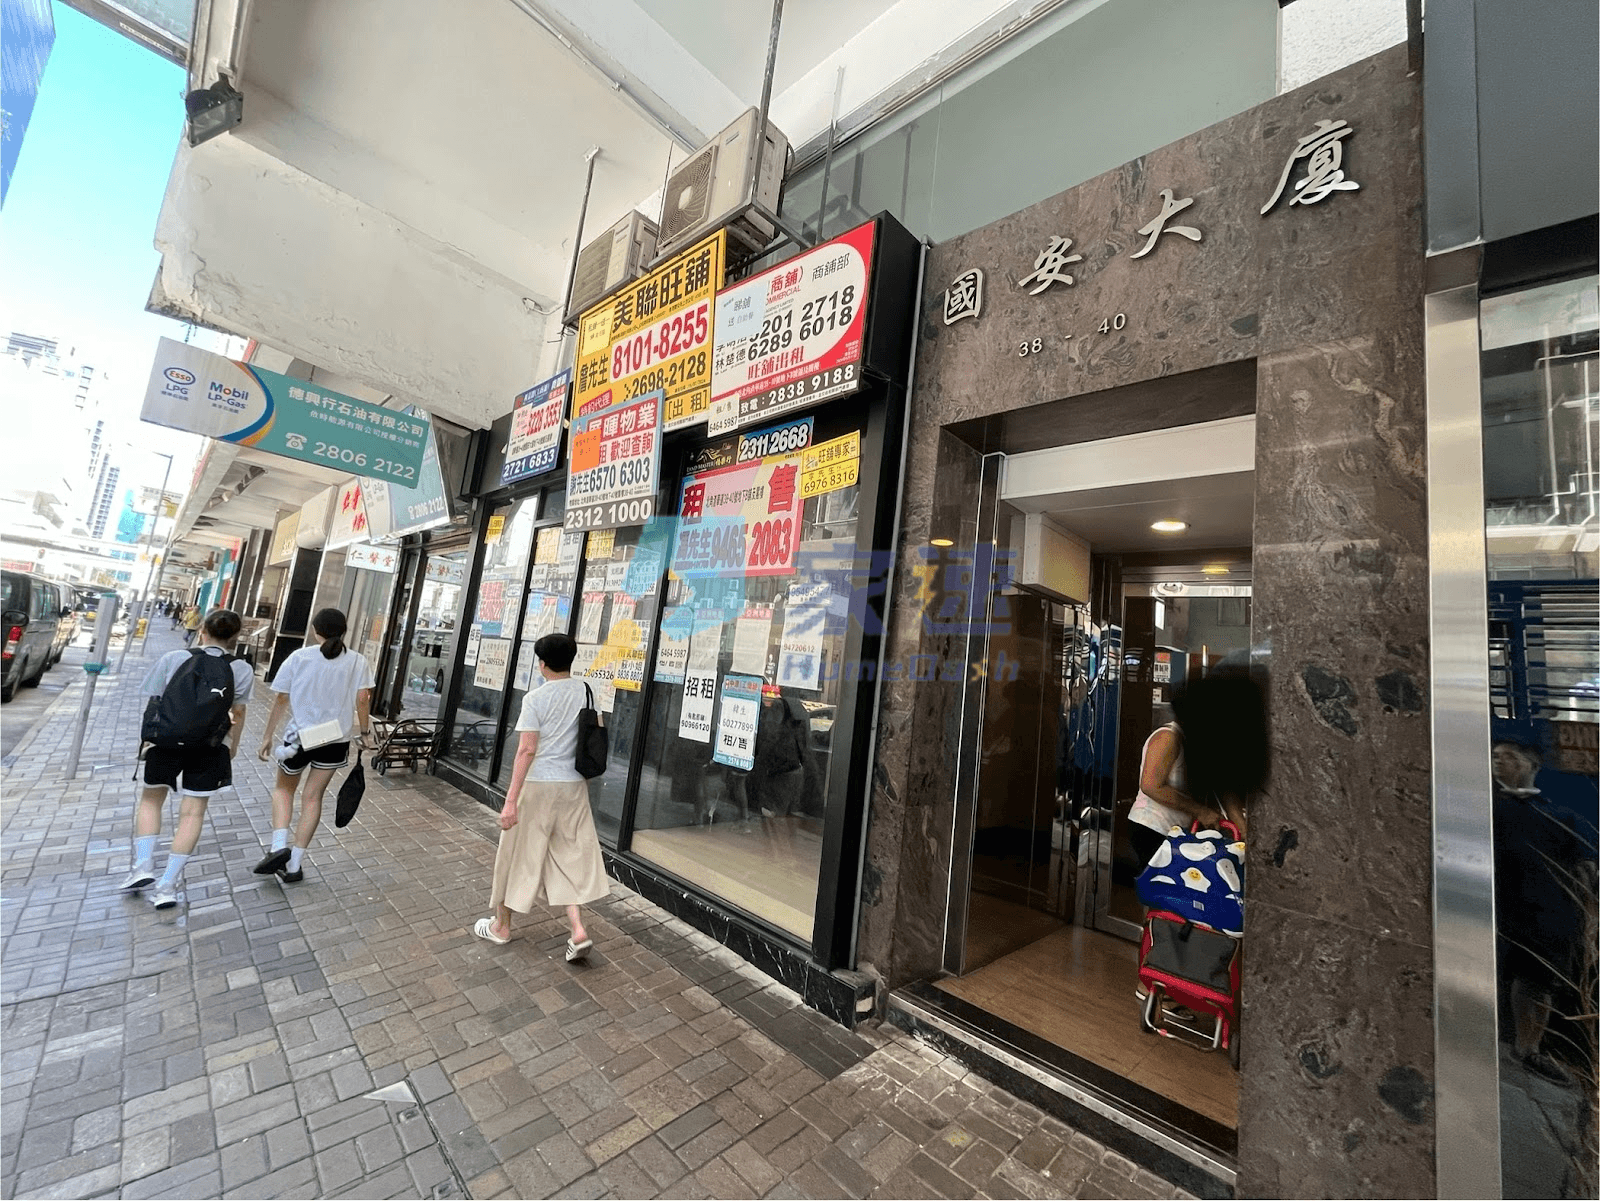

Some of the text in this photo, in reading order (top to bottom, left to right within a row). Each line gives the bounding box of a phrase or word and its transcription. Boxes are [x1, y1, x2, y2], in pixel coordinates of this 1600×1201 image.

[812, 252, 850, 282] 商舖部
[613, 249, 711, 334] 美聯旺舖
[801, 285, 855, 322] 2718
[613, 303, 708, 379] 8101-8255
[748, 330, 793, 361] 6289
[800, 305, 853, 341] 6018
[1018, 336, 1043, 357] 38
[1097, 313, 1126, 334] 40
[166, 383, 189, 395] LPG
[208, 392, 247, 410] LP-Gas
[210, 381, 249, 401] Mobil
[769, 381, 805, 406] 2838
[811, 364, 854, 391] 9188
[288, 386, 424, 438] 德興行石油有限公司
[313, 441, 415, 481] 2806 2122
[503, 459, 526, 478] 2721
[529, 448, 555, 468] 6833
[610, 432, 654, 462] 歡迎查詢
[589, 464, 616, 493] 6570
[619, 457, 650, 486] 6303
[768, 464, 799, 515] 售
[804, 469, 856, 493] 6976 8316
[565, 499, 652, 530] 2312 1000
[710, 524, 748, 568] 9465
[748, 517, 792, 567] 2083
[684, 677, 715, 700] 招租
[722, 718, 754, 733] 60277899
